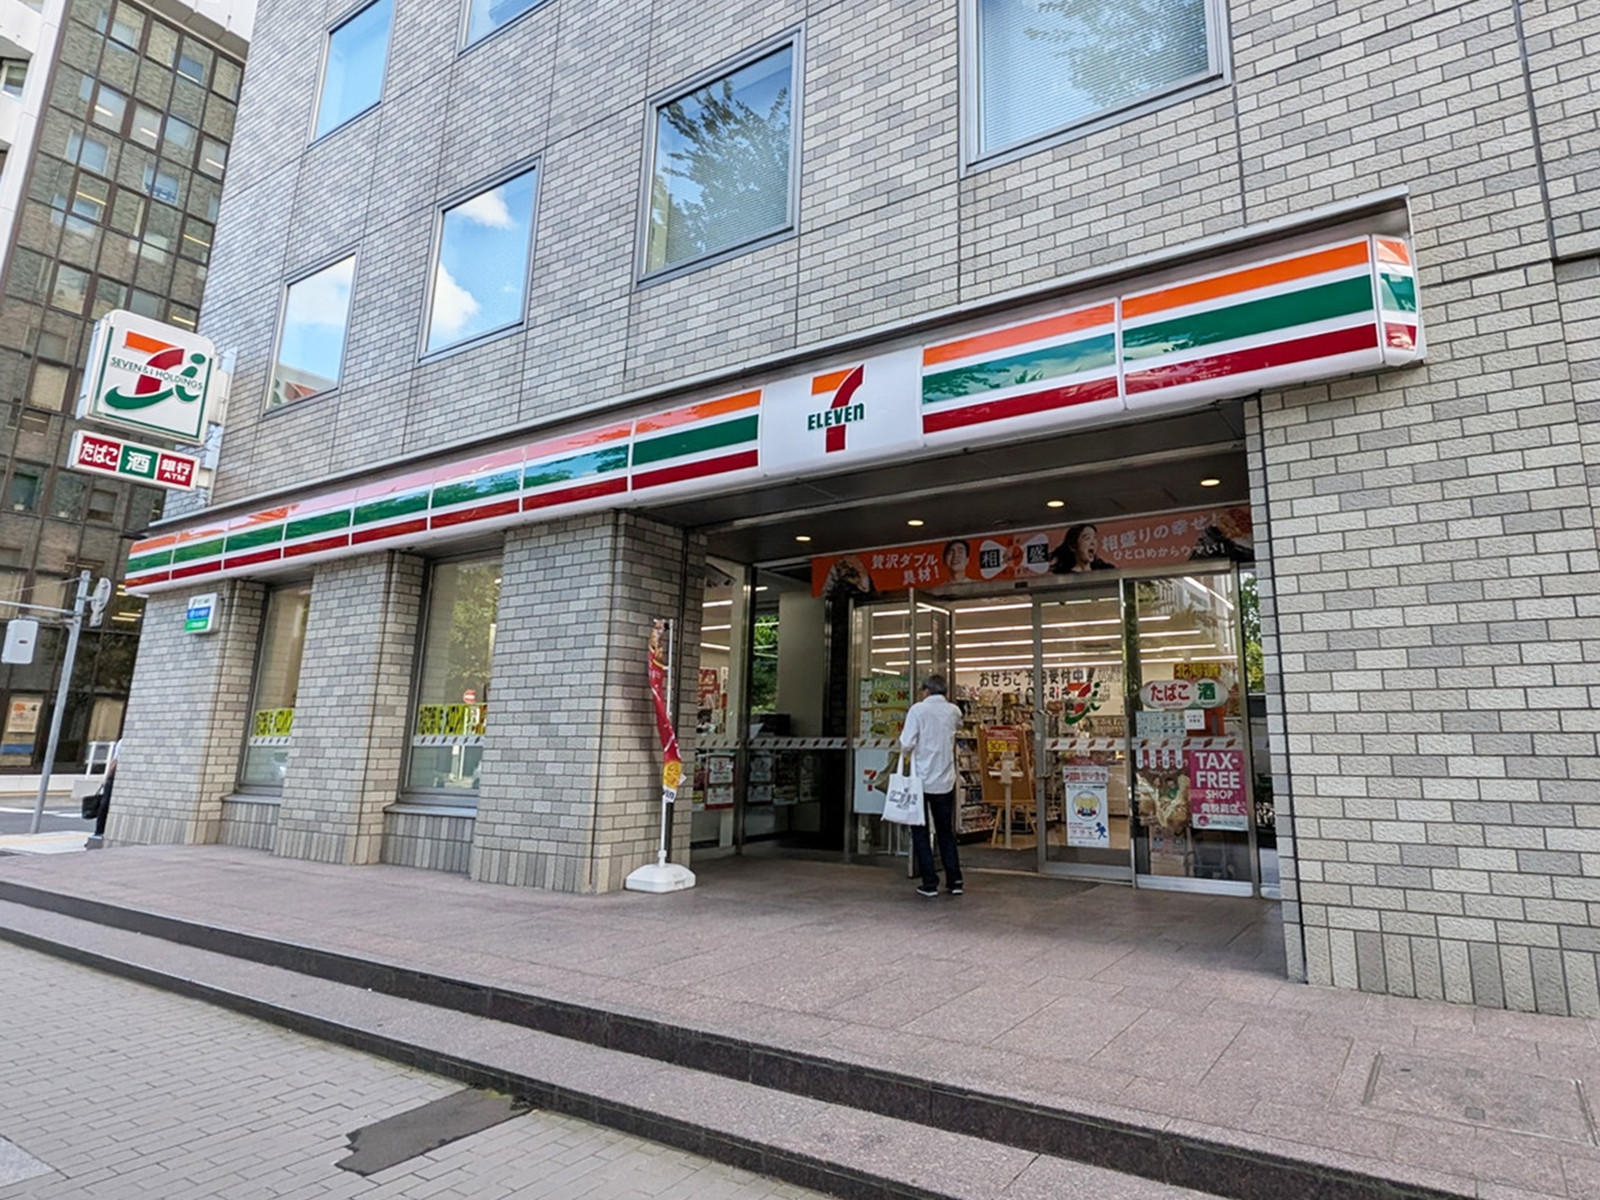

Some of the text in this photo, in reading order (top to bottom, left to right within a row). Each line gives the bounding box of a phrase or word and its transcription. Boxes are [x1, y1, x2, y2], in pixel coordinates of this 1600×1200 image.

[155, 370, 203, 390] HOLDINGS
[80, 441, 192, 475] たばこ 酒 銀行
[163, 471, 187, 482] ATM
[1150, 682, 1216, 701] たばこ 酒
[1194, 752, 1239, 770] TAX-
[1196, 771, 1241, 789] FREE
[1205, 789, 1234, 800] SHOP
